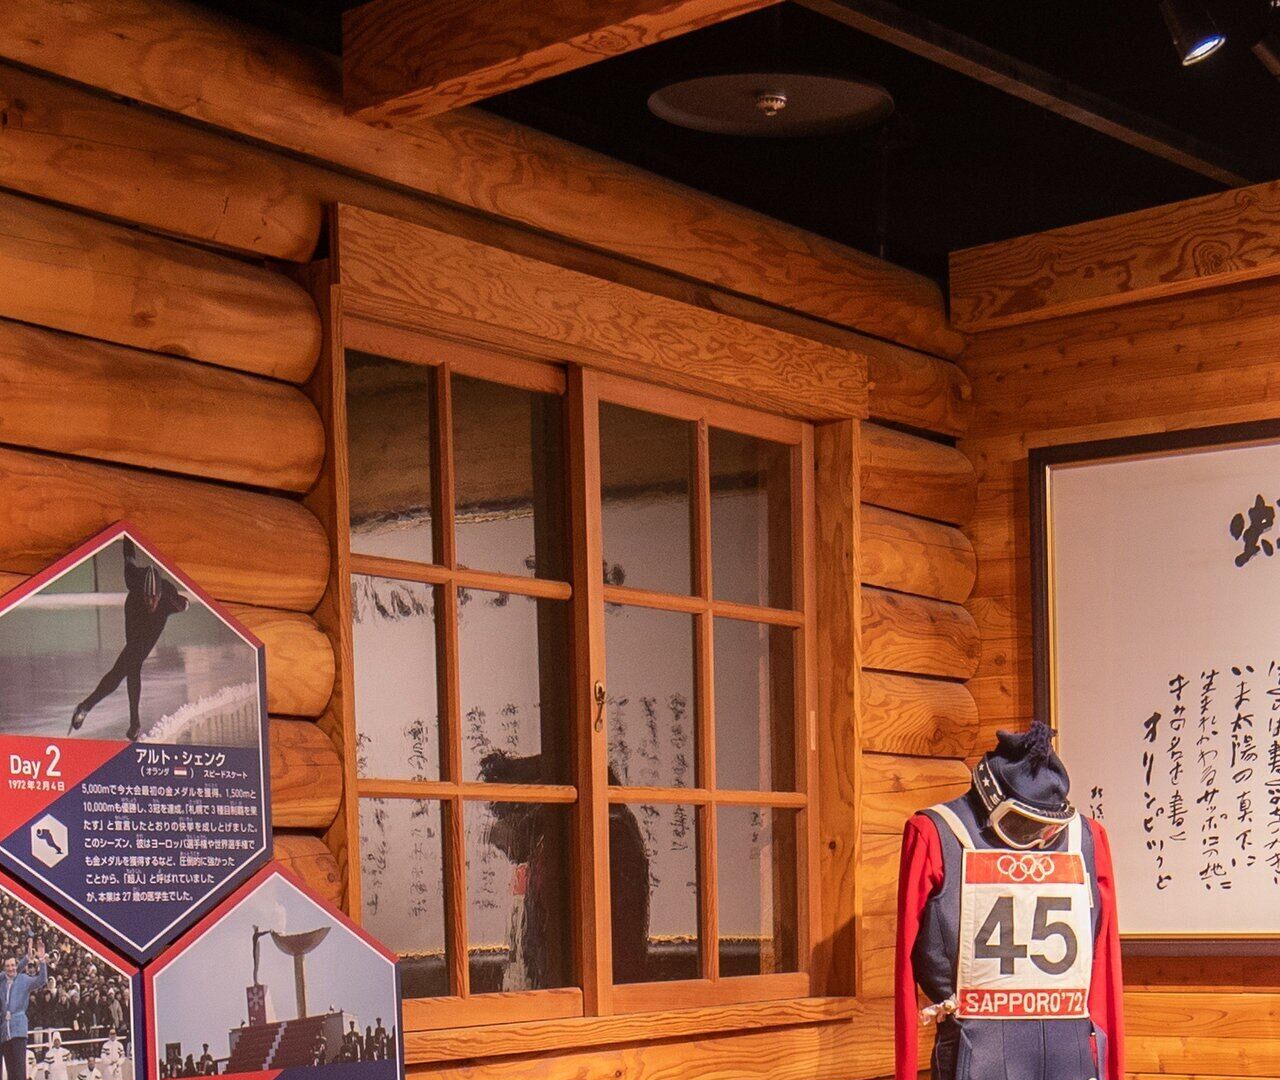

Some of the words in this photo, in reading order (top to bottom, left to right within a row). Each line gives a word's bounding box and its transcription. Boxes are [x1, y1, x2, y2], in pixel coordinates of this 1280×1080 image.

[9, 754, 41, 780] Day
[45, 744, 62, 778] 2
[135, 748, 226, 767] アルト・シェンク
[974, 895, 1078, 976] 45
